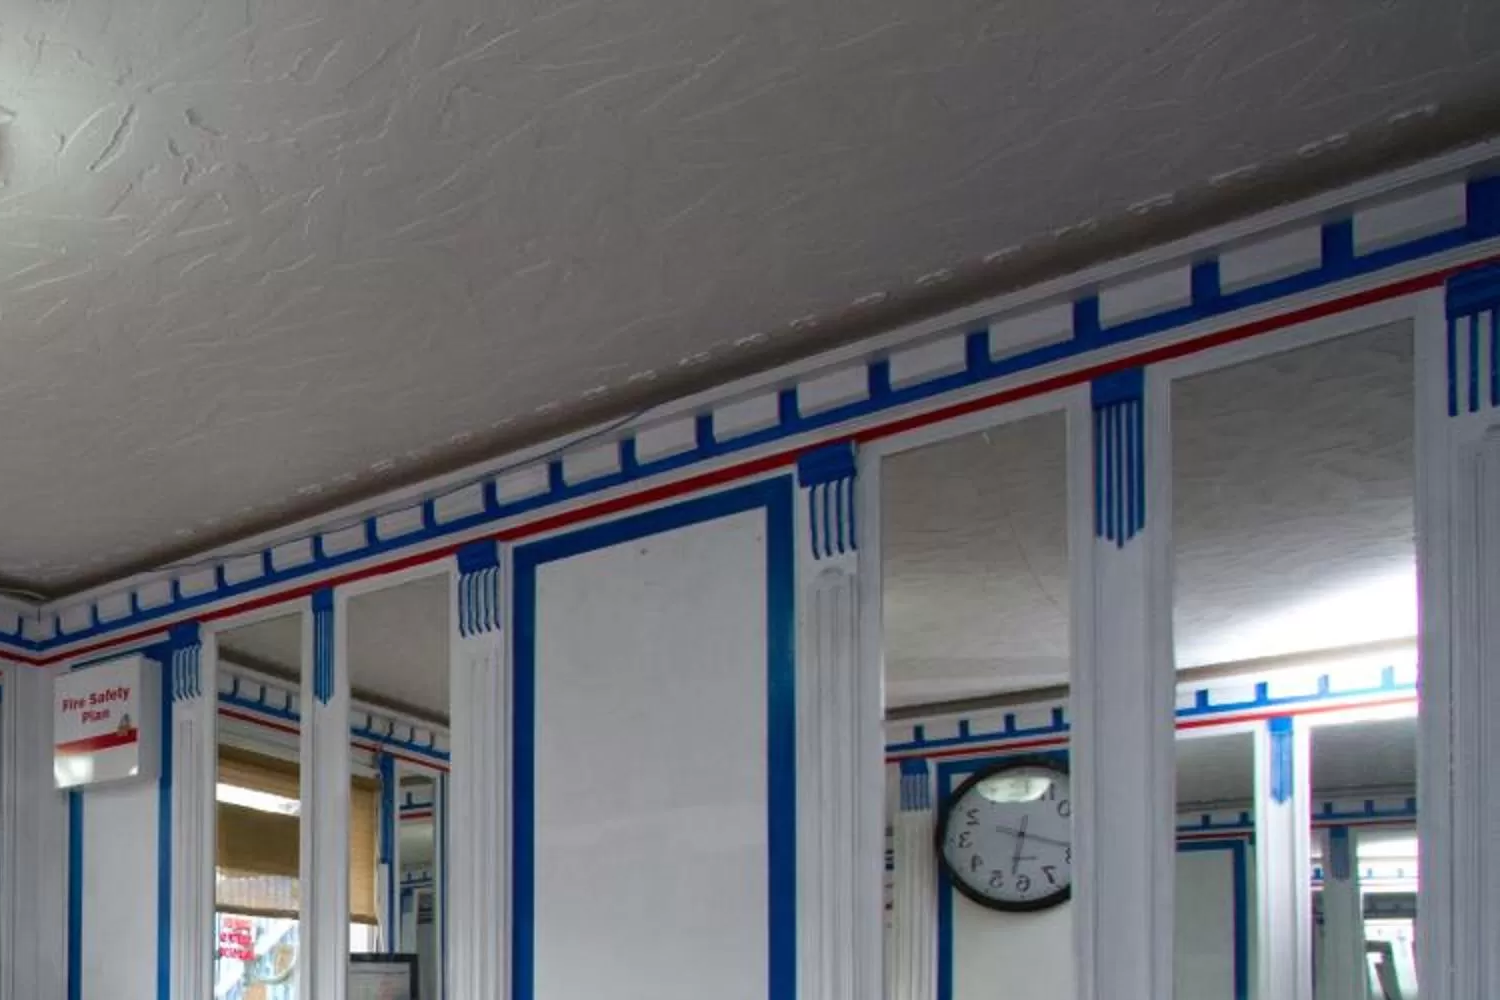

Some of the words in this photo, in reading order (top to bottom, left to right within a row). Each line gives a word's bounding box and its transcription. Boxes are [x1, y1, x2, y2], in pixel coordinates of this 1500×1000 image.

[62, 698, 86, 713] Fire
[89, 687, 131, 706] Safety
[82, 709, 110, 724] Plan
